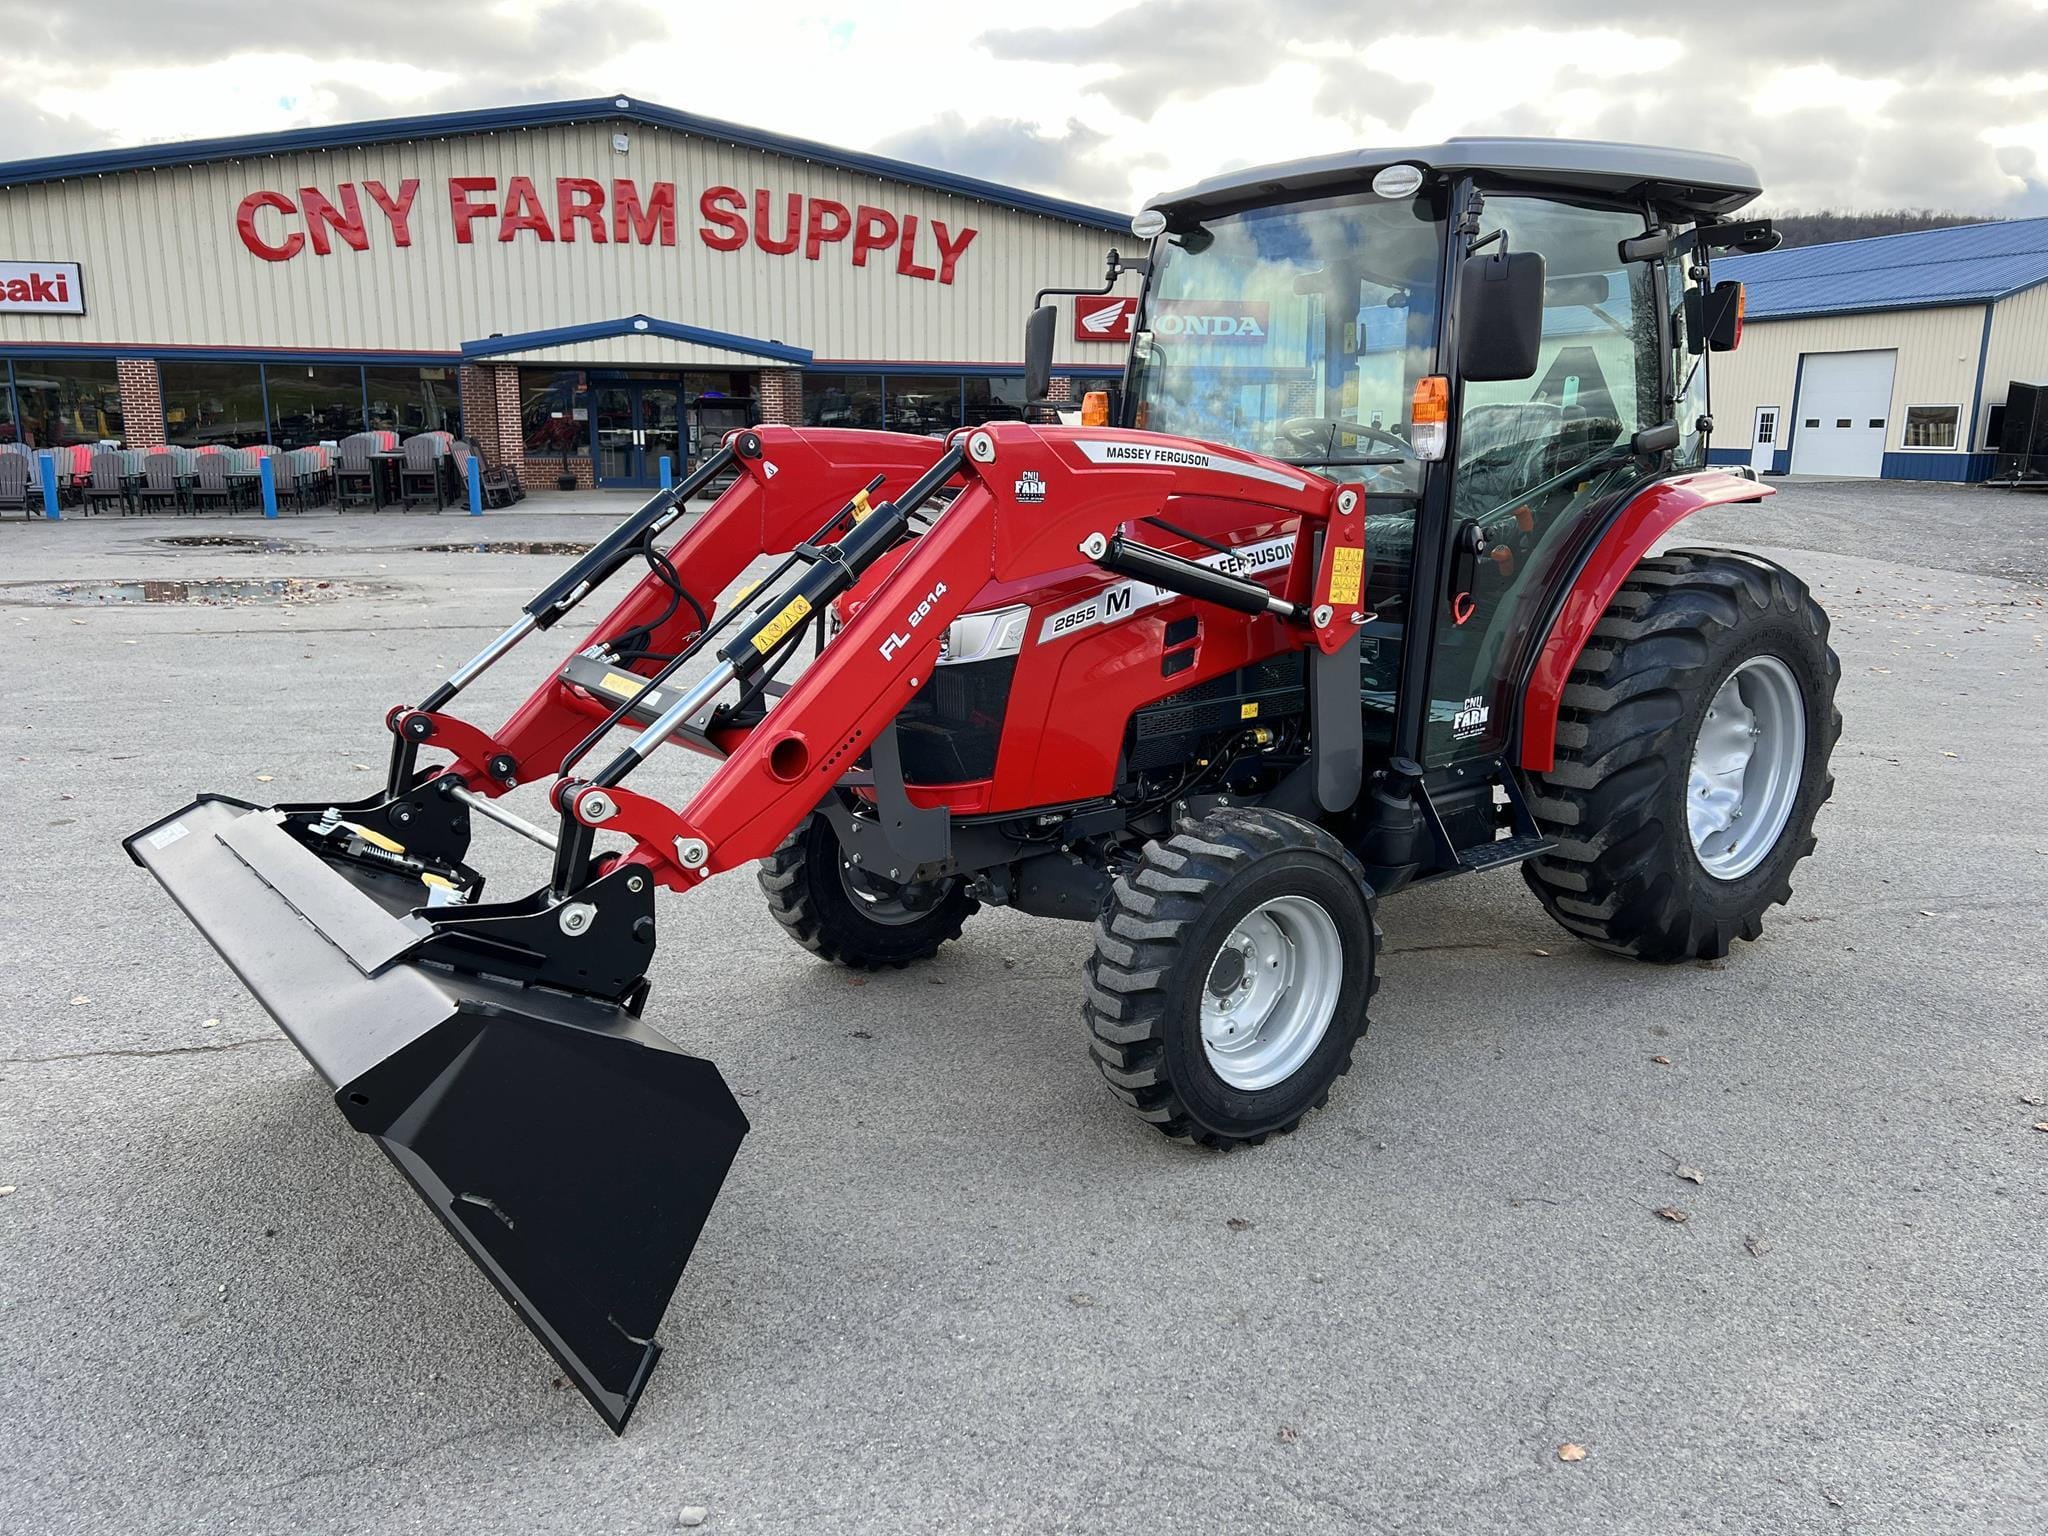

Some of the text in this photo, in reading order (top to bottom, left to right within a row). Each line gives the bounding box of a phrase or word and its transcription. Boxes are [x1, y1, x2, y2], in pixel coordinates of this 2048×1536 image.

[236, 176, 979, 285] CNY FARM SUPPLY
[1106, 447, 1210, 467] MASSEY FERGUSON
[1014, 480, 1046, 494] FARM
[879, 581, 947, 662] FL 2814
[1053, 587, 1131, 633] 2855 M
[1453, 706, 1489, 730] FARM
